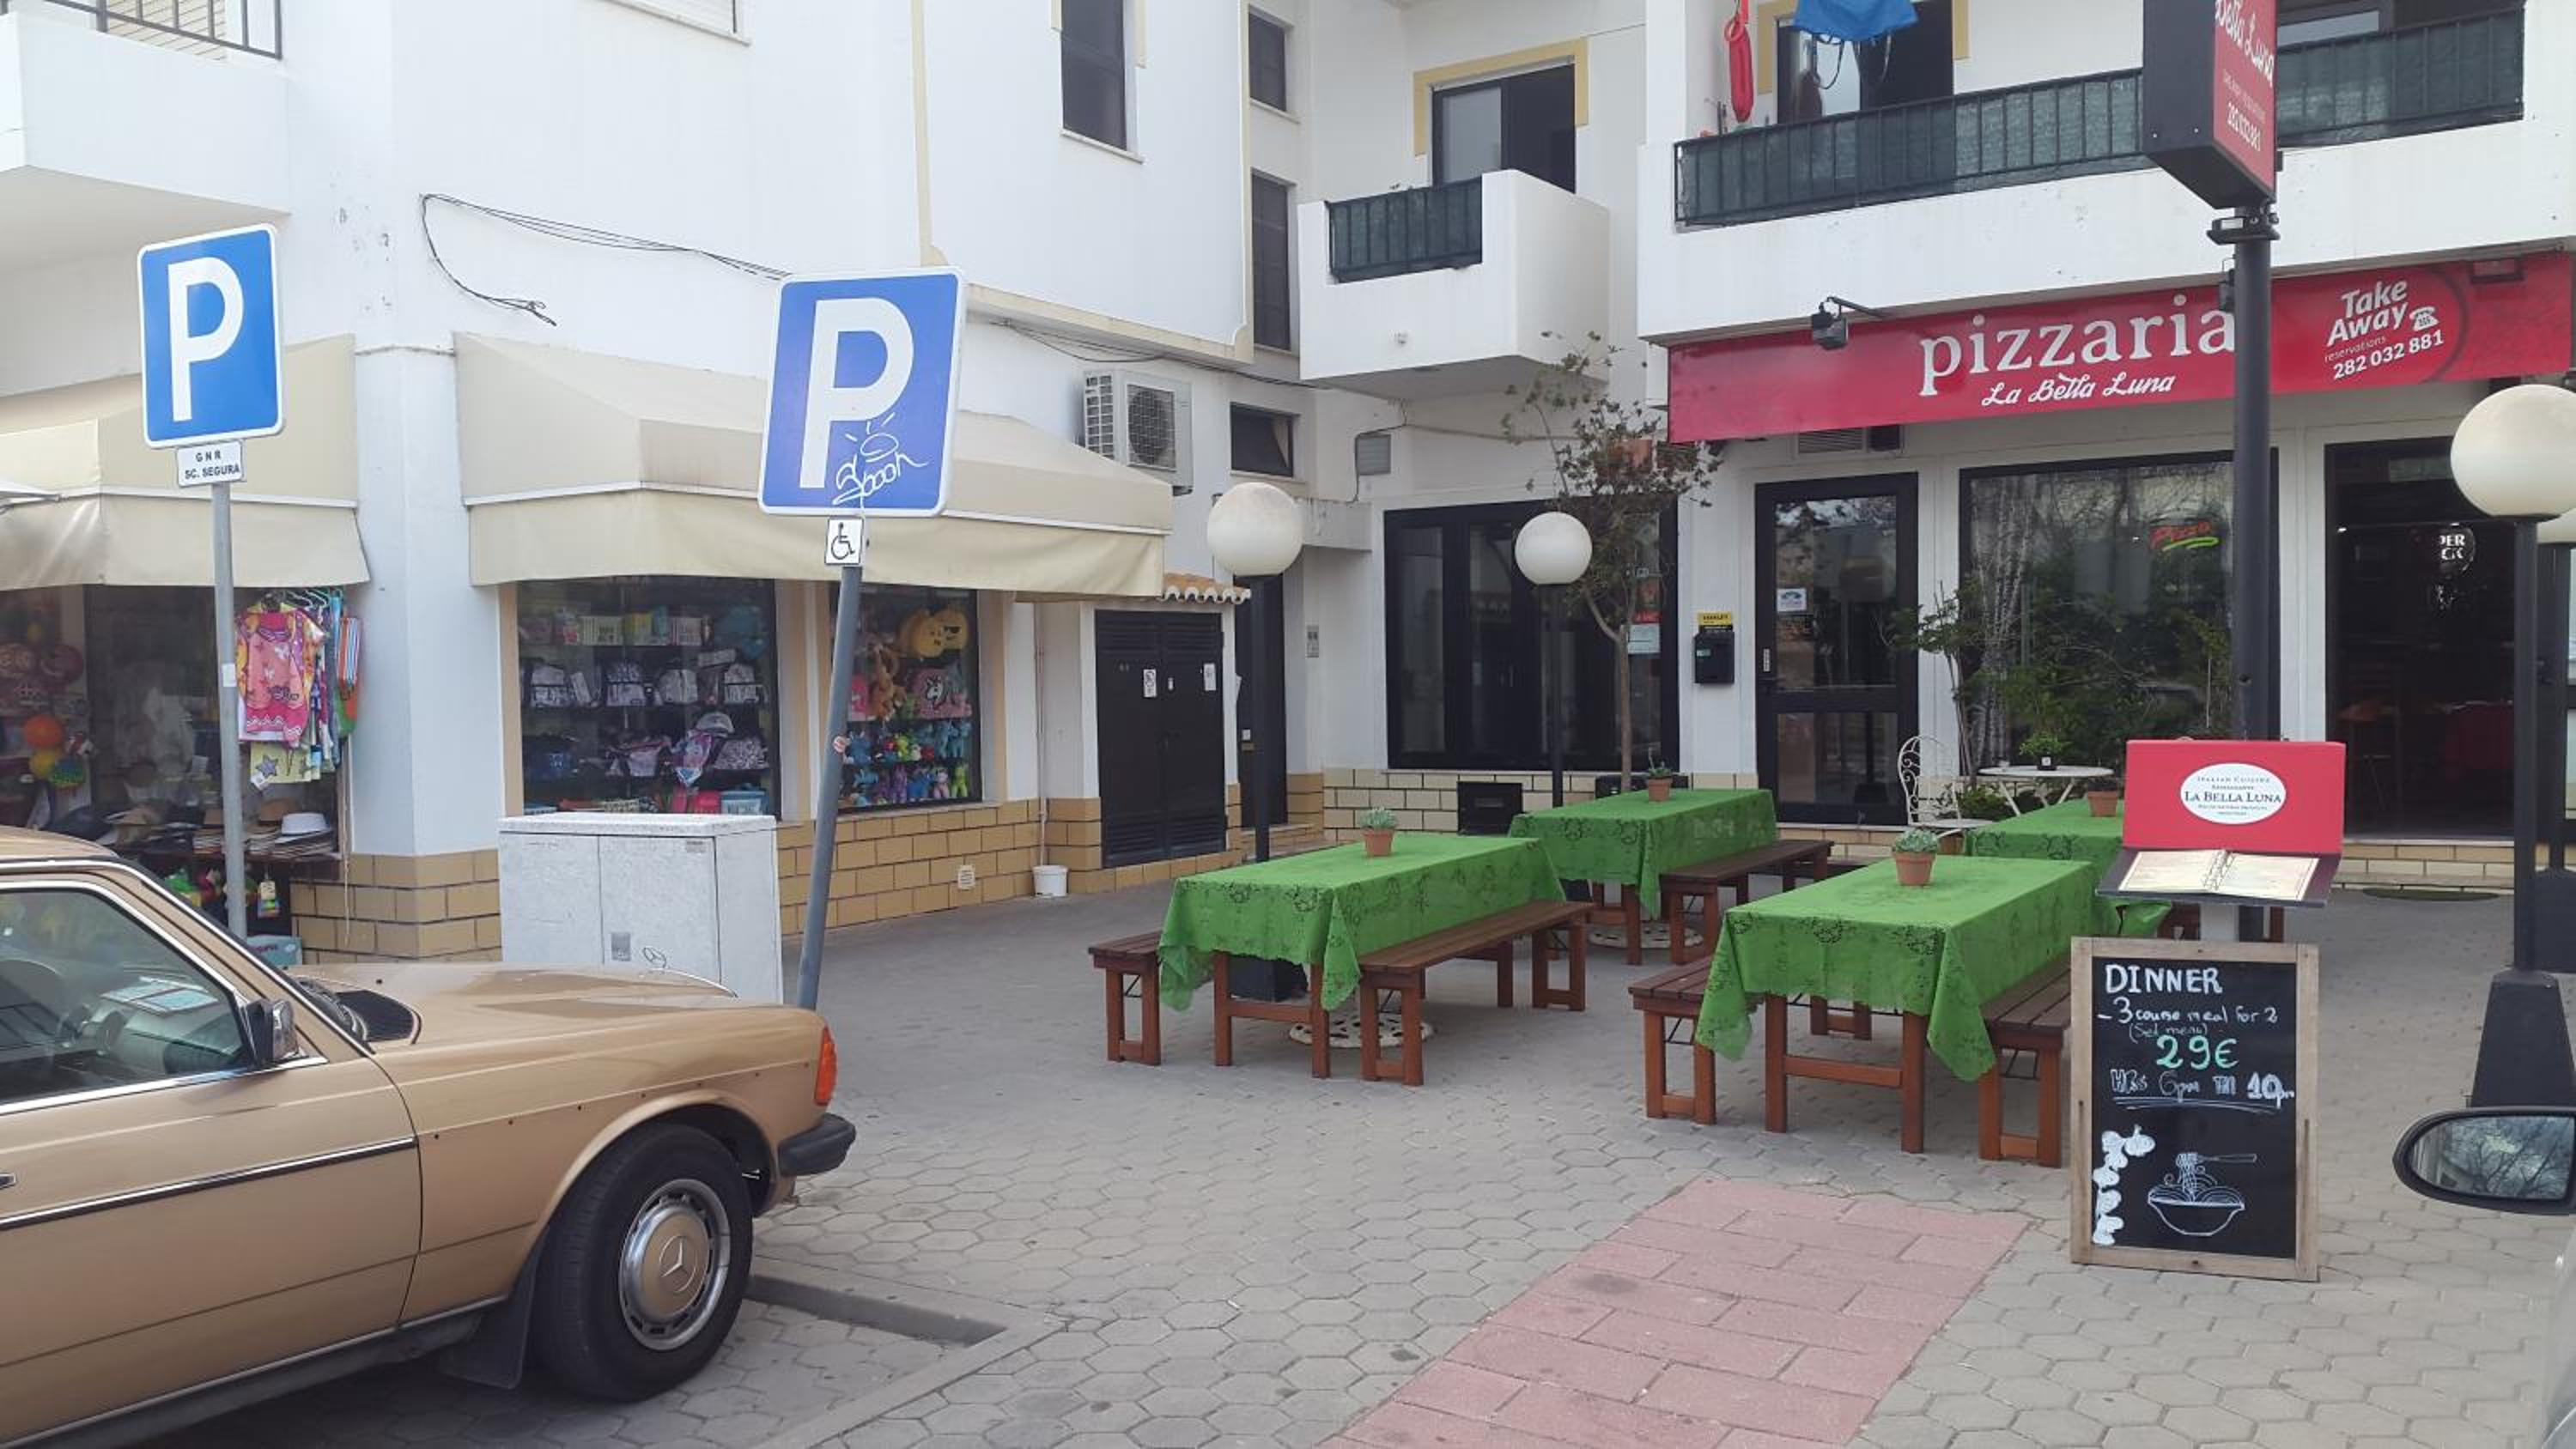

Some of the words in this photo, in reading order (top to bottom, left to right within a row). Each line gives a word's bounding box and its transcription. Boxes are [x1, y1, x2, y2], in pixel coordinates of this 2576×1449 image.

[2341, 280, 2408, 318] Take
[167, 256, 245, 422] P
[2326, 301, 2409, 347] Away
[1918, 294, 2234, 397] pizzaria
[2324, 335, 2386, 362] reservations
[2333, 355, 2367, 380] 282
[2370, 343, 2405, 367] 032
[2409, 329, 2445, 354] 881
[799, 297, 914, 488] P
[1981, 382, 2022, 406] La
[2027, 372, 2096, 403] Bella
[2102, 371, 2176, 396] Luna
[202, 463, 240, 478] SEGURA
[2184, 790, 2201, 803] LA
[2203, 790, 2244, 803] BELLA
[2246, 791, 2281, 803] LUNA
[2105, 963, 2223, 995] DINNER
[2136, 1008, 2181, 1022] course
[2187, 1005, 2228, 1023] meal
[2235, 1005, 2260, 1023] for
[2263, 1007, 2279, 1023] 2
[2156, 1034, 2240, 1070] 29€
